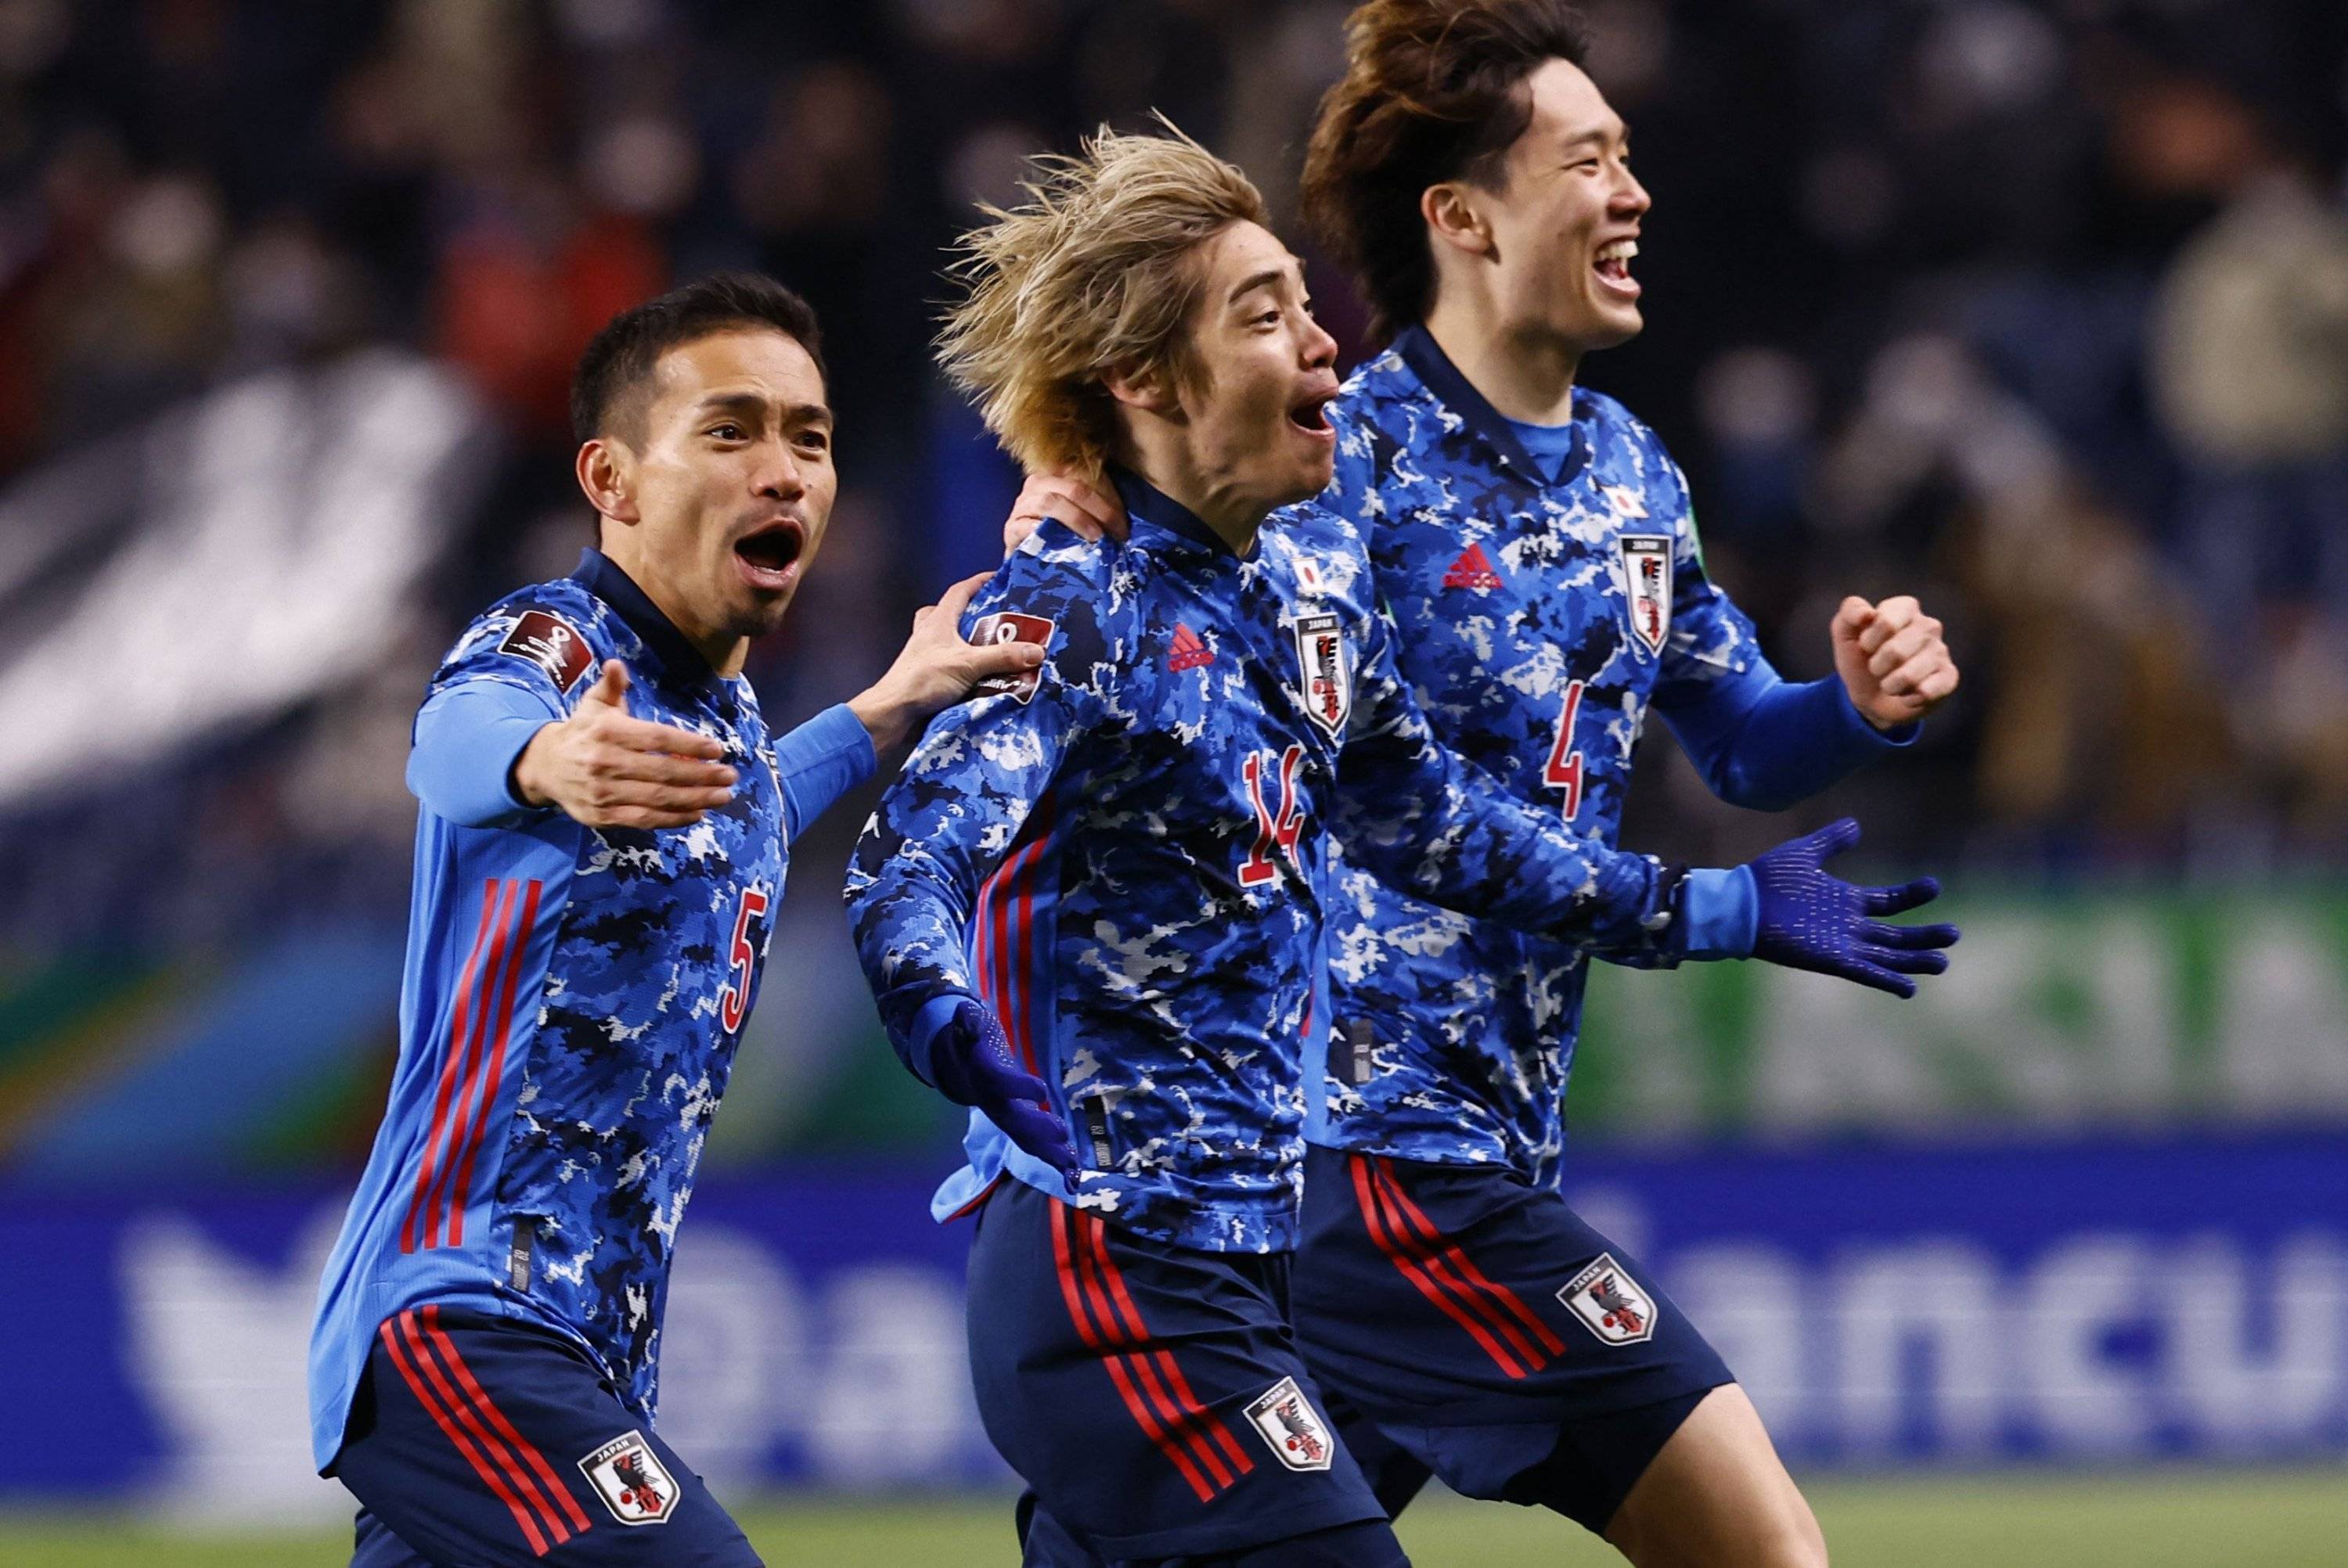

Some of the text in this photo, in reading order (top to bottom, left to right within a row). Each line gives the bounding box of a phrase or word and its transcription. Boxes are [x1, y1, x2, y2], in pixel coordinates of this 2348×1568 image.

[1237, 744, 1306, 887] 14
[1542, 679, 1583, 822] 4
[722, 886, 768, 1034] 5
[1572, 1266, 1601, 1291] JAPAN
[597, 1439, 629, 1462] JAPAN
